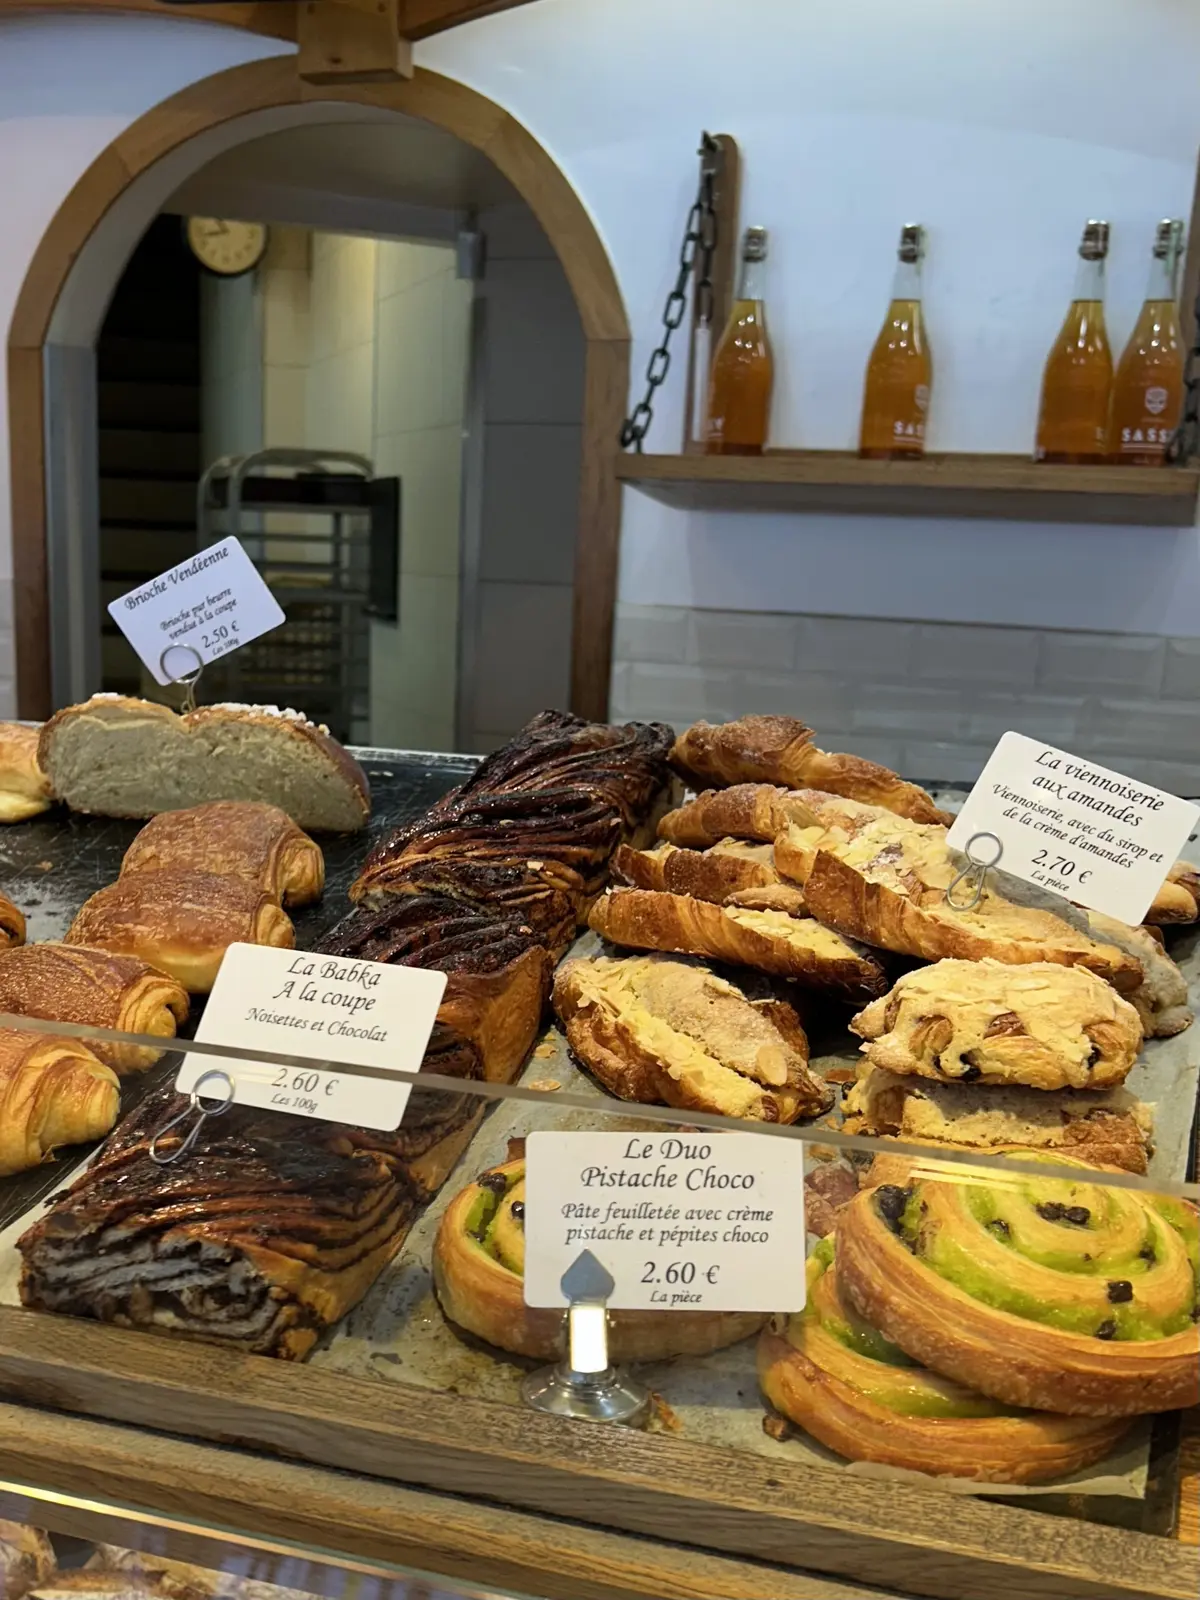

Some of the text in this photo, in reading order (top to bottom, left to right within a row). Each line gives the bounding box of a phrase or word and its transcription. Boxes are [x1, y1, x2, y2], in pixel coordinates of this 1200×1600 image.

[124, 547, 229, 610] Brioche Vendéenne
[160, 608, 190, 631] Brioche
[204, 609, 214, 621] la
[214, 598, 237, 616] coupe
[201, 620, 240, 649] 2.50 €
[1034, 750, 1165, 812] La viennoiserie
[1032, 775, 1143, 827] aux amandes
[992, 783, 1164, 864] Viennoiserie, avec du sirop et
[1002, 806, 1134, 870] de la crème d'amandes
[1030, 869, 1070, 893] La pièce
[1031, 848, 1093, 885] 2.70 €
[286, 956, 382, 990] La Babka
[272, 980, 376, 1016] A la coupe
[244, 1007, 388, 1043] Noisettes et Chocolat
[270, 1067, 340, 1096] 2.60 €
[270, 1093, 319, 1113] Les 100g
[622, 1138, 712, 1160] Le Duo
[580, 1164, 755, 1191] Pistache Choco
[561, 1202, 774, 1224] Pâte feuilletée avec crème
[564, 1225, 769, 1247] pistache et pépites choco
[640, 1261, 720, 1285] 2.60 €
[650, 1290, 703, 1307] La pièce
